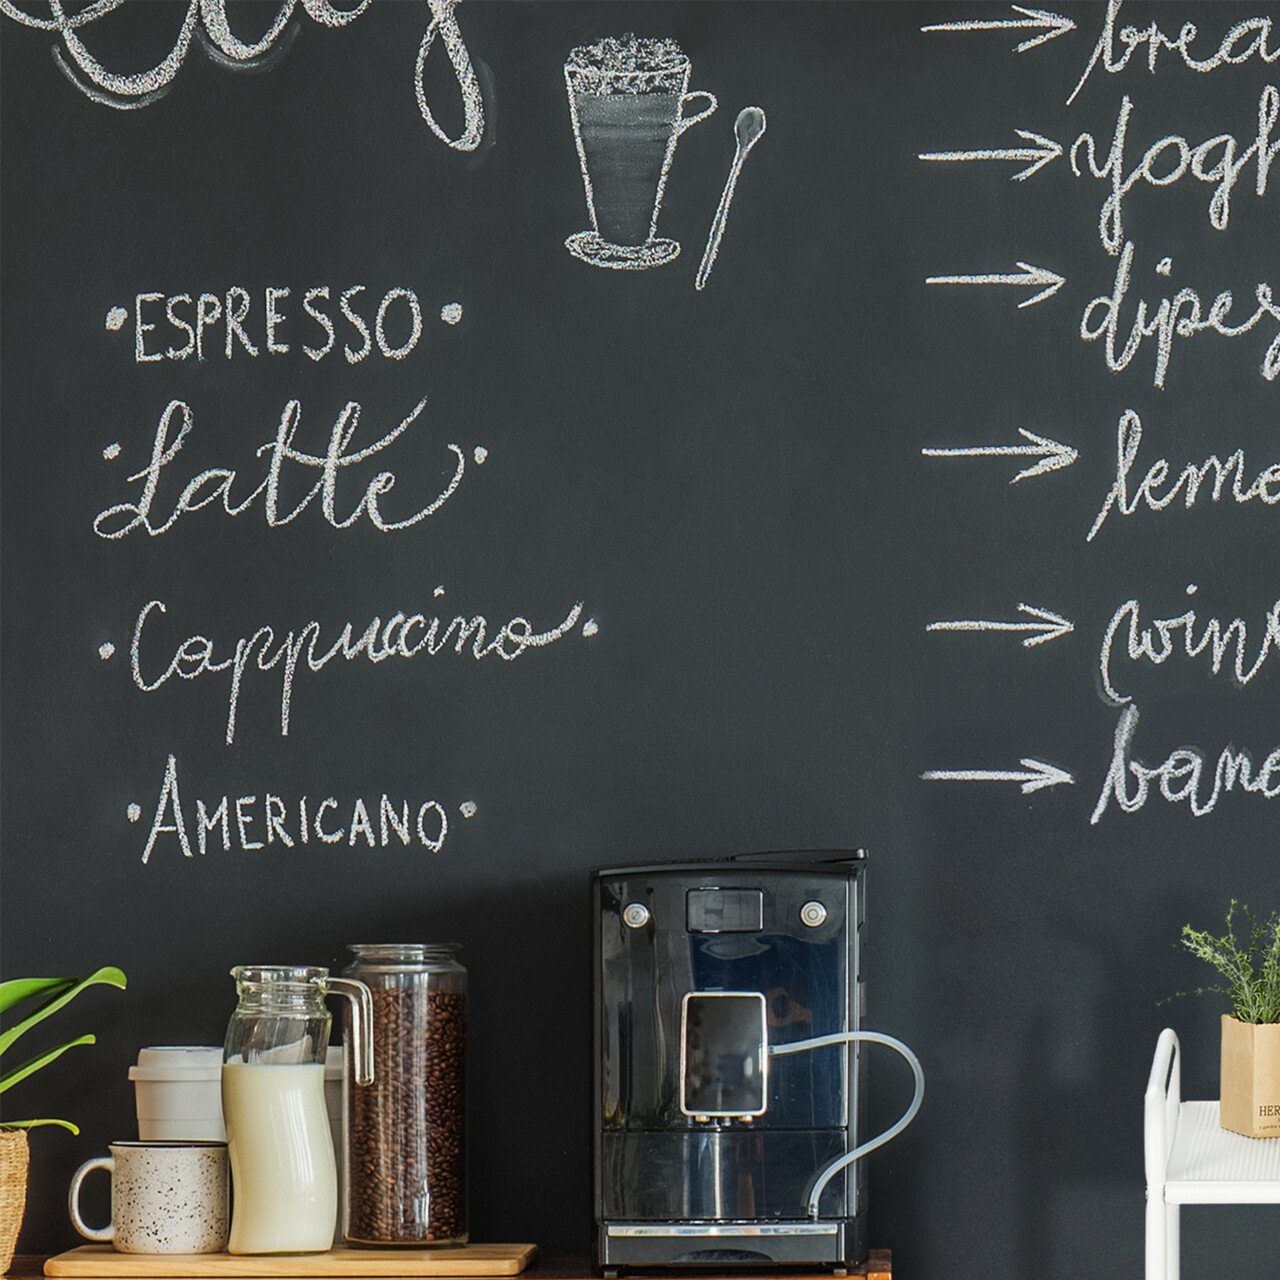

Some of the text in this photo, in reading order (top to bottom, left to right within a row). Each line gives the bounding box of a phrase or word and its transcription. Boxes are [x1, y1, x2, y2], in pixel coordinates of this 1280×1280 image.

[134, 285, 423, 364] ESPRESSO
[93, 396, 465, 540] Latte
[142, 754, 448, 864] AMERICANO
